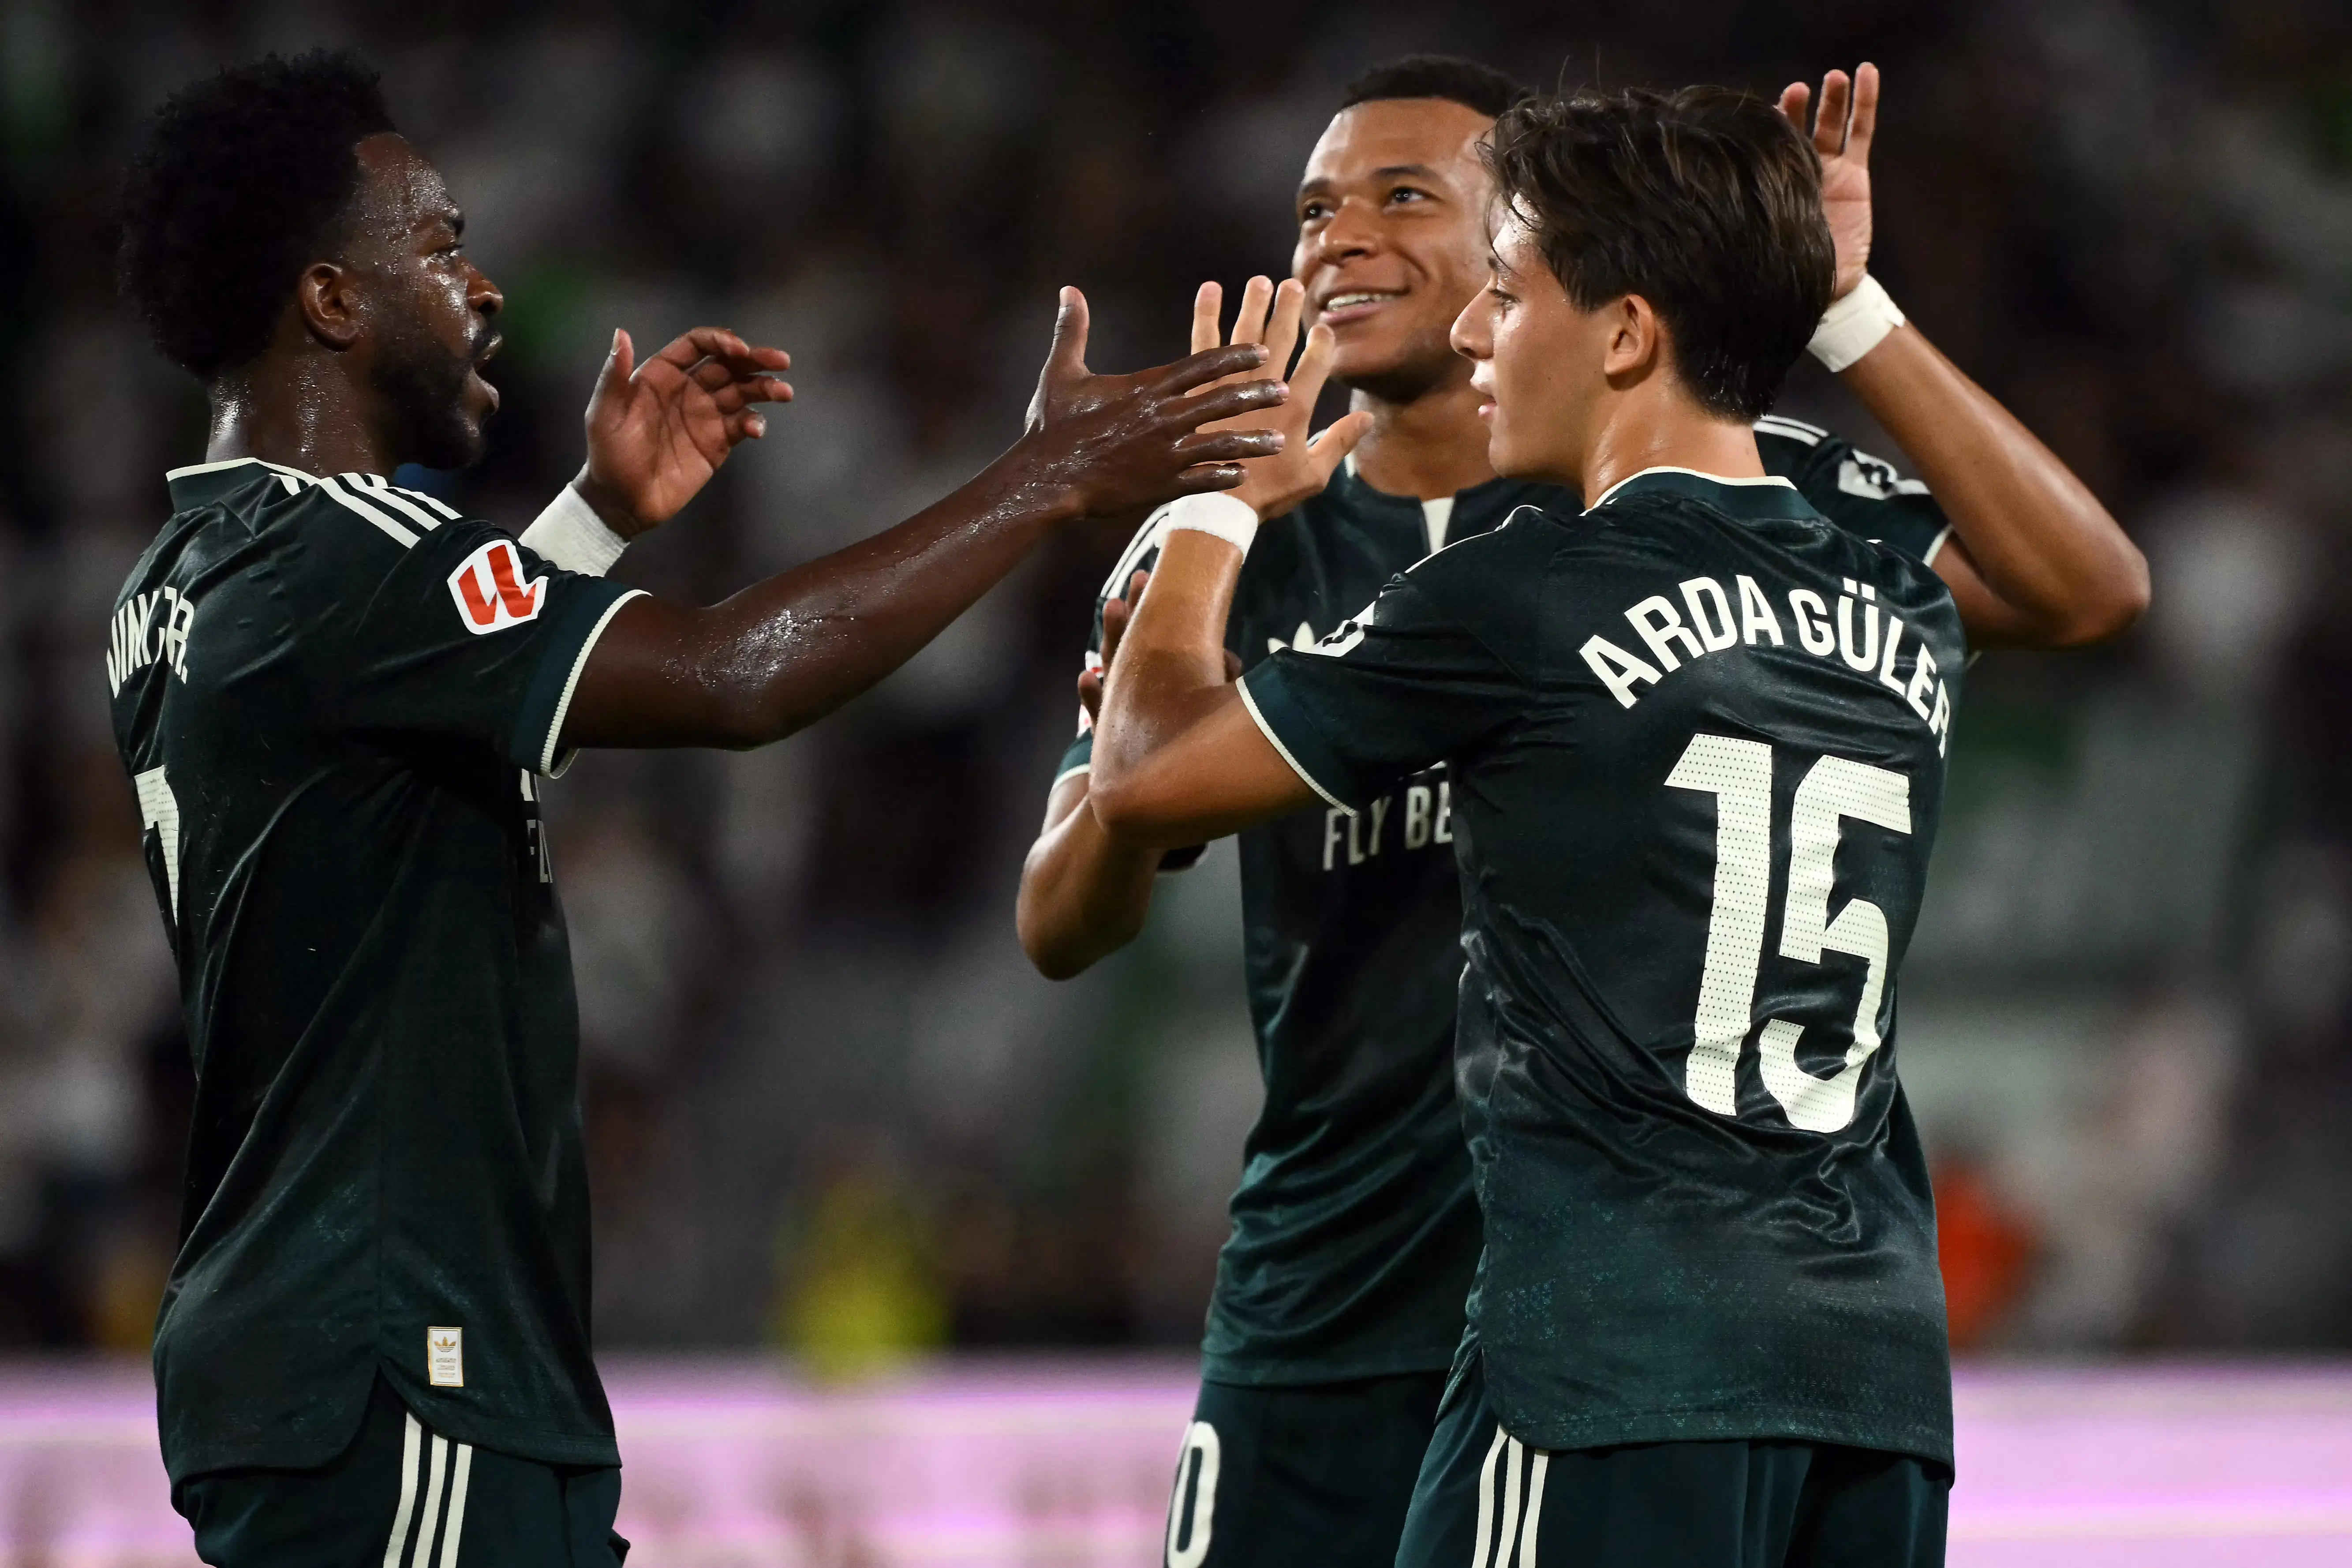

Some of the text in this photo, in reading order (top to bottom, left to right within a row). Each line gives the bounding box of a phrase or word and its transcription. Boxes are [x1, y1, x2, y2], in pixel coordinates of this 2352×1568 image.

[1578, 574, 1950, 759] ARDA GÜLER
[1323, 795, 1393, 872] FLY
[1663, 733, 1912, 1134] 15
